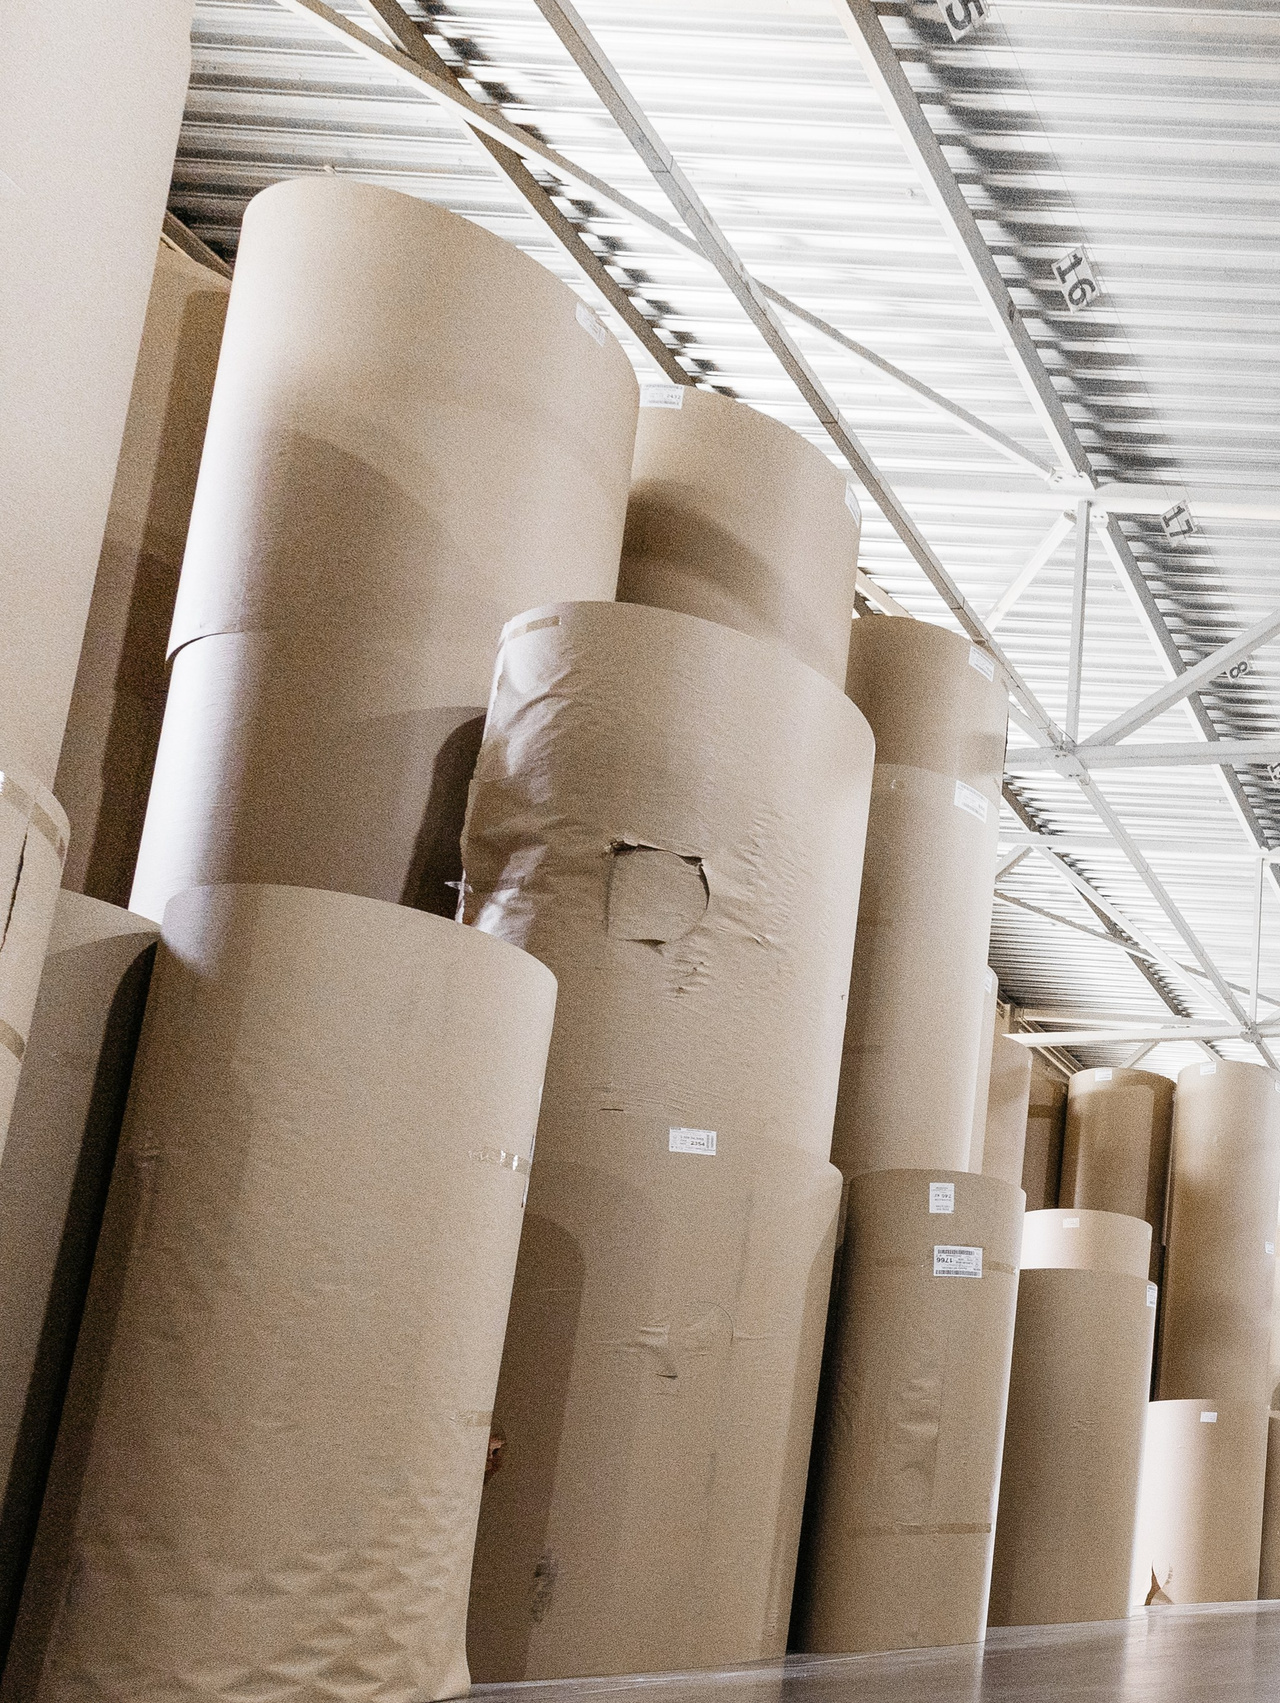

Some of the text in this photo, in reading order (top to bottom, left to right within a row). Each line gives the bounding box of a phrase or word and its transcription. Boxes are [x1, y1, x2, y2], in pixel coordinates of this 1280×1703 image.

[945, 0, 984, 31] 5
[1056, 253, 1096, 306] 16
[1162, 505, 1193, 538] 17
[1229, 661, 1248, 679] 8
